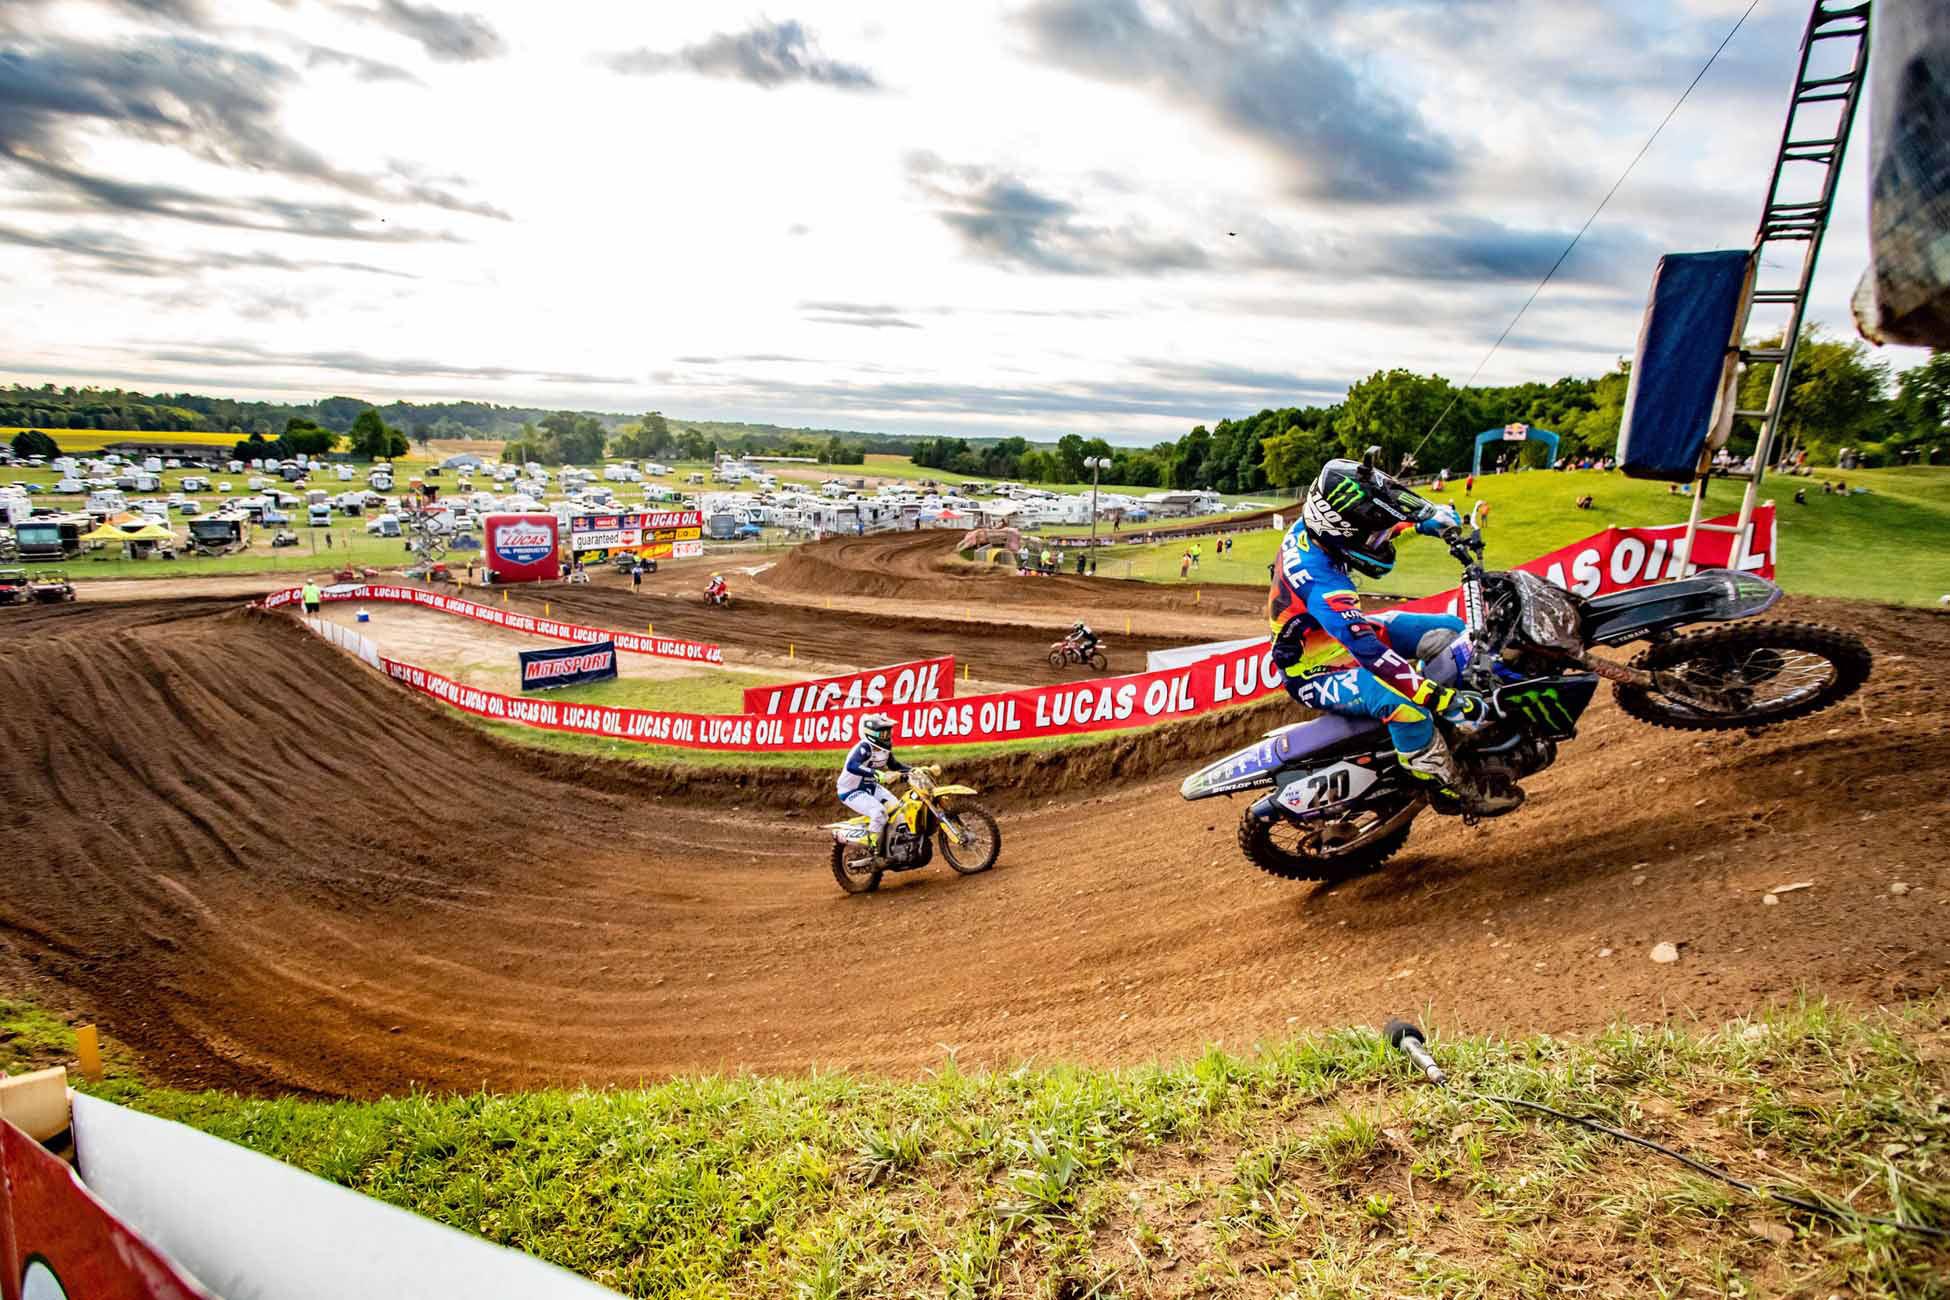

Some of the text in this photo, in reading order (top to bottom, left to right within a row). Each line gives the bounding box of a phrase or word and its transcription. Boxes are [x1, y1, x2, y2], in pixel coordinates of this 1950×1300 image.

[645, 511, 698, 527] LUCAS OIL
[502, 535, 546, 546] LUCAS
[577, 534, 619, 549] guaranteed
[1282, 532, 1312, 589] CKLE
[374, 587, 412, 600] LUCAS OIL
[415, 591, 434, 604] LUCAS
[446, 599, 465, 612] LUCAS
[537, 621, 570, 638] LUCAS OIL
[573, 627, 597, 642] LUCAS
[614, 635, 654, 652] LUCAS OIL
[657, 640, 685, 657] LUCAS
[687, 645, 703, 658] OIL
[892, 664, 940, 704] OIL
[1214, 650, 1284, 702] LUC
[460, 688, 504, 716] LUCAS OIL
[1035, 671, 1195, 727] LUCAS OIL
[508, 701, 557, 724] LUCAS OIL
[563, 706, 622, 733] LUCAS OIL
[901, 704, 974, 738] LUCAS
[980, 700, 1021, 734] OIL
[628, 713, 694, 742] LUCAS OIL
[700, 719, 784, 745] LUCAS OIL
[793, 714, 854, 744] LUCAS
[1212, 782, 1252, 793] DUNLOP
[1307, 769, 1350, 809] 20
